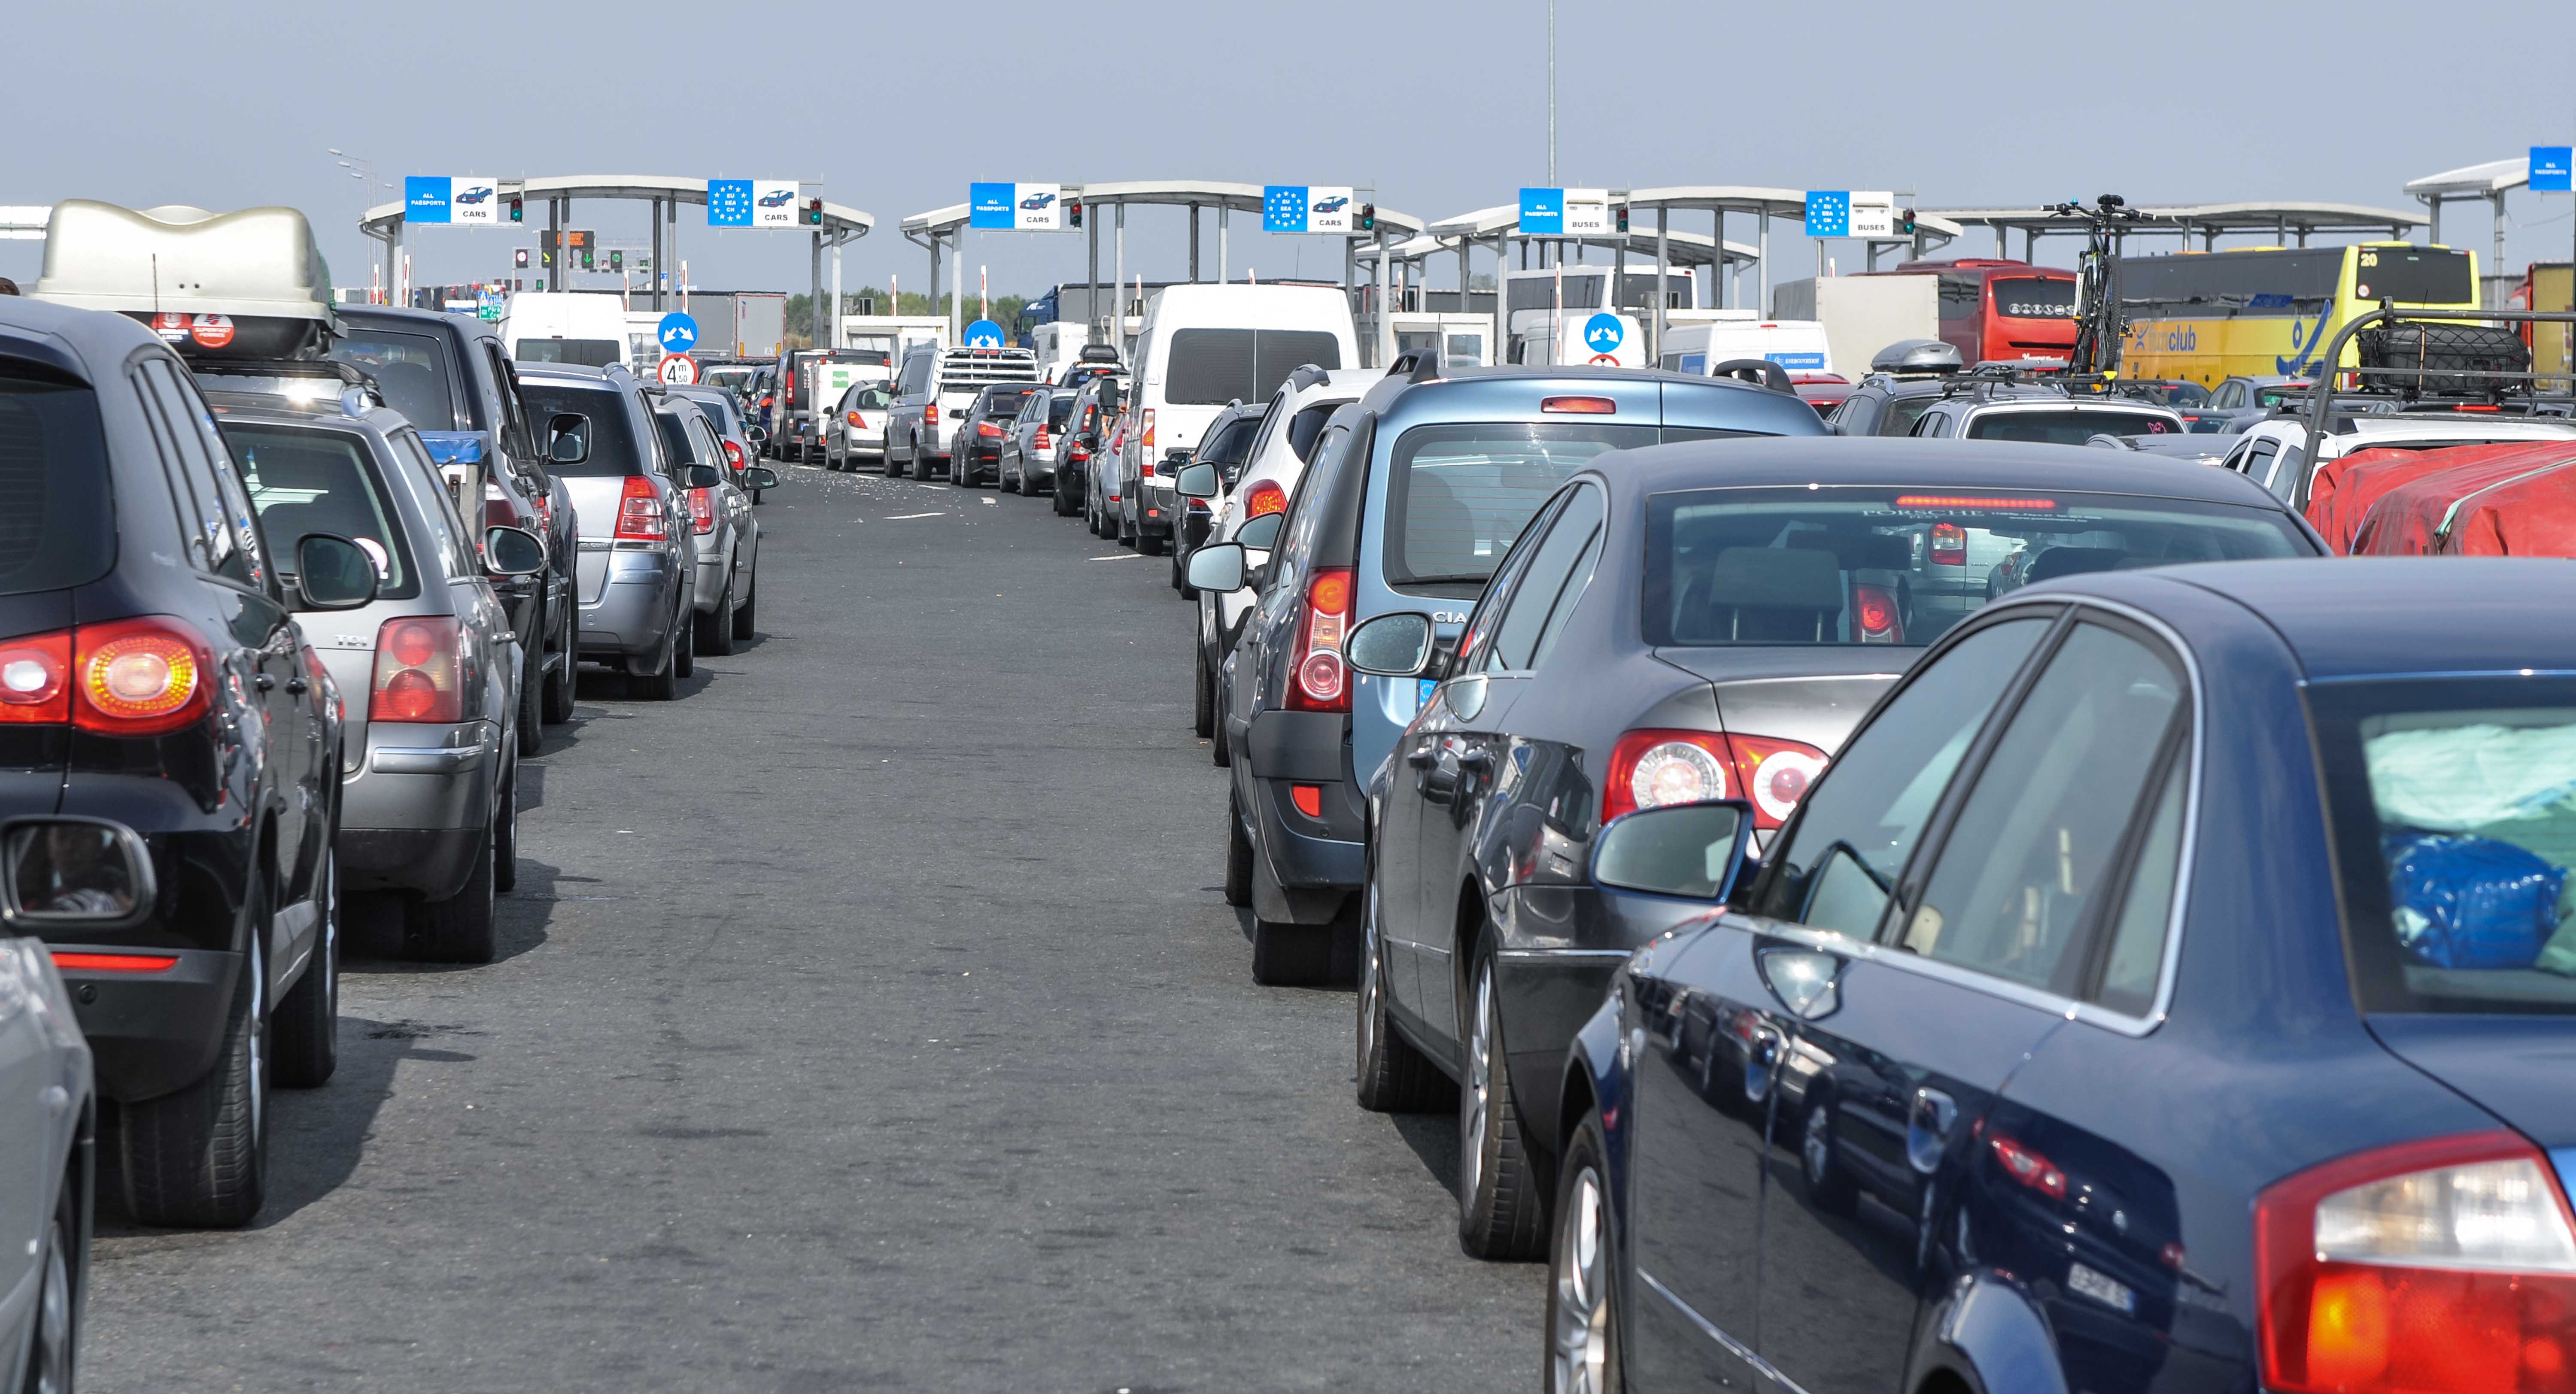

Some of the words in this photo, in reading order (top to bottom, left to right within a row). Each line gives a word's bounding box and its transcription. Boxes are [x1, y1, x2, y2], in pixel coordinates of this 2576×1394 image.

[2360, 253, 2378, 267] 20
[667, 365, 676, 383] 4
[334, 635, 368, 646] TDI
